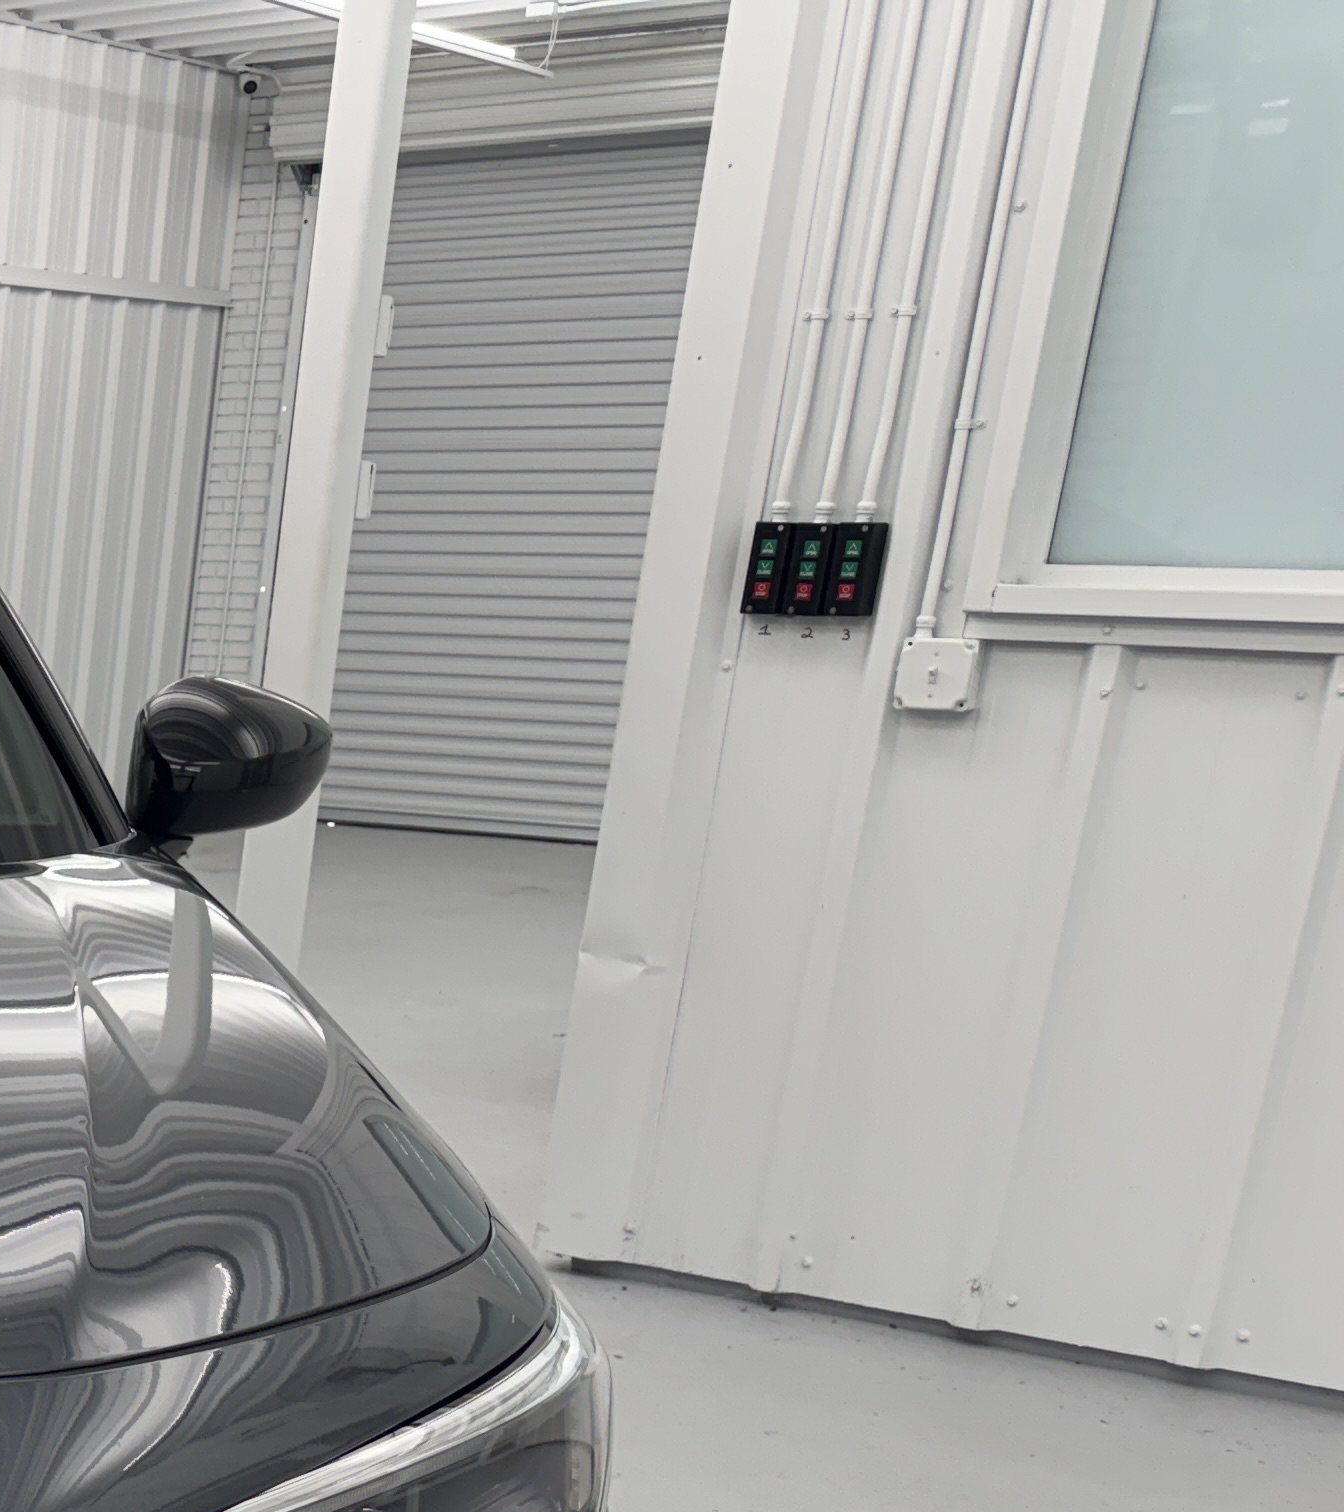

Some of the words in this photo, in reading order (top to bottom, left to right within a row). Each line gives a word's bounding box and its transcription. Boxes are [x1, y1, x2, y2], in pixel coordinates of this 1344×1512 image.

[757, 624, 772, 636] 1
[800, 626, 814, 639] 2
[841, 629, 851, 641] 3
